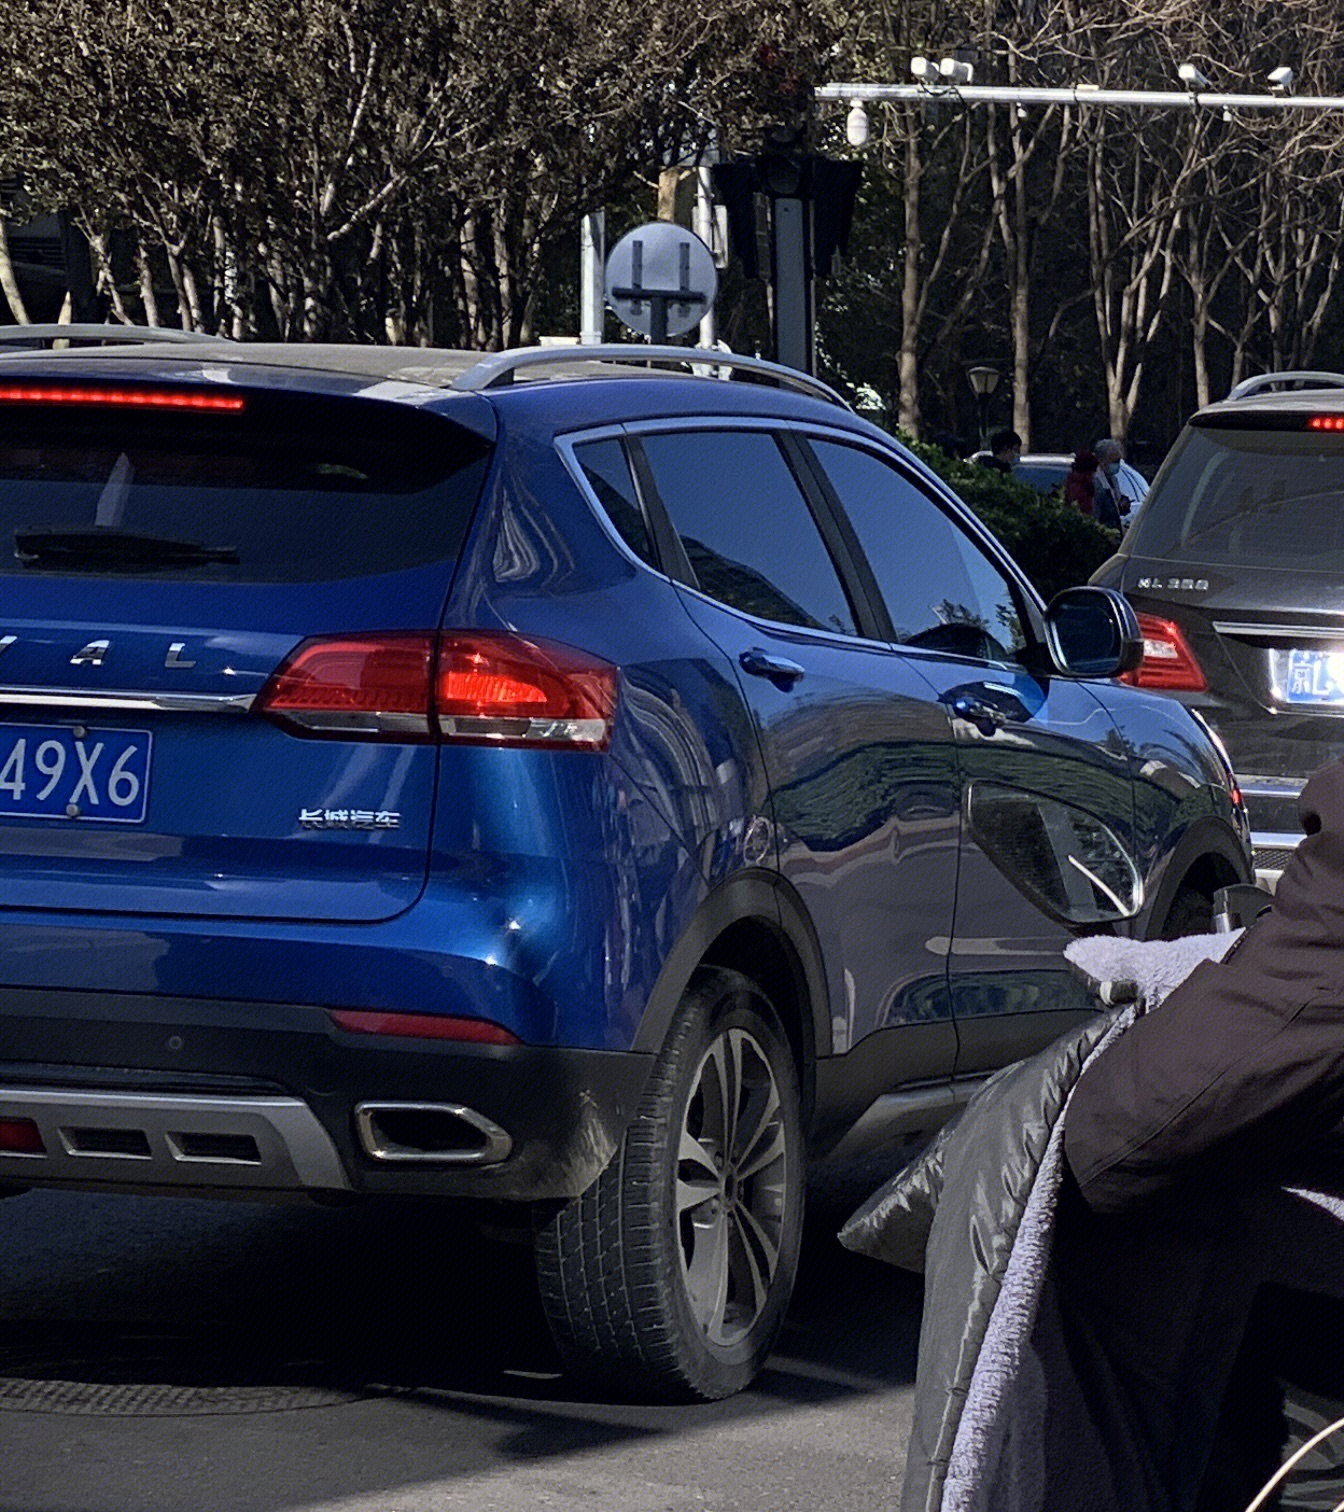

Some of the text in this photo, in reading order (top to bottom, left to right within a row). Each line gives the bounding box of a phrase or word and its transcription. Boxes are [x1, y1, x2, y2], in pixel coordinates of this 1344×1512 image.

[0, 738, 139, 806] 49X6
[299, 809, 400, 829] 长城汽车
